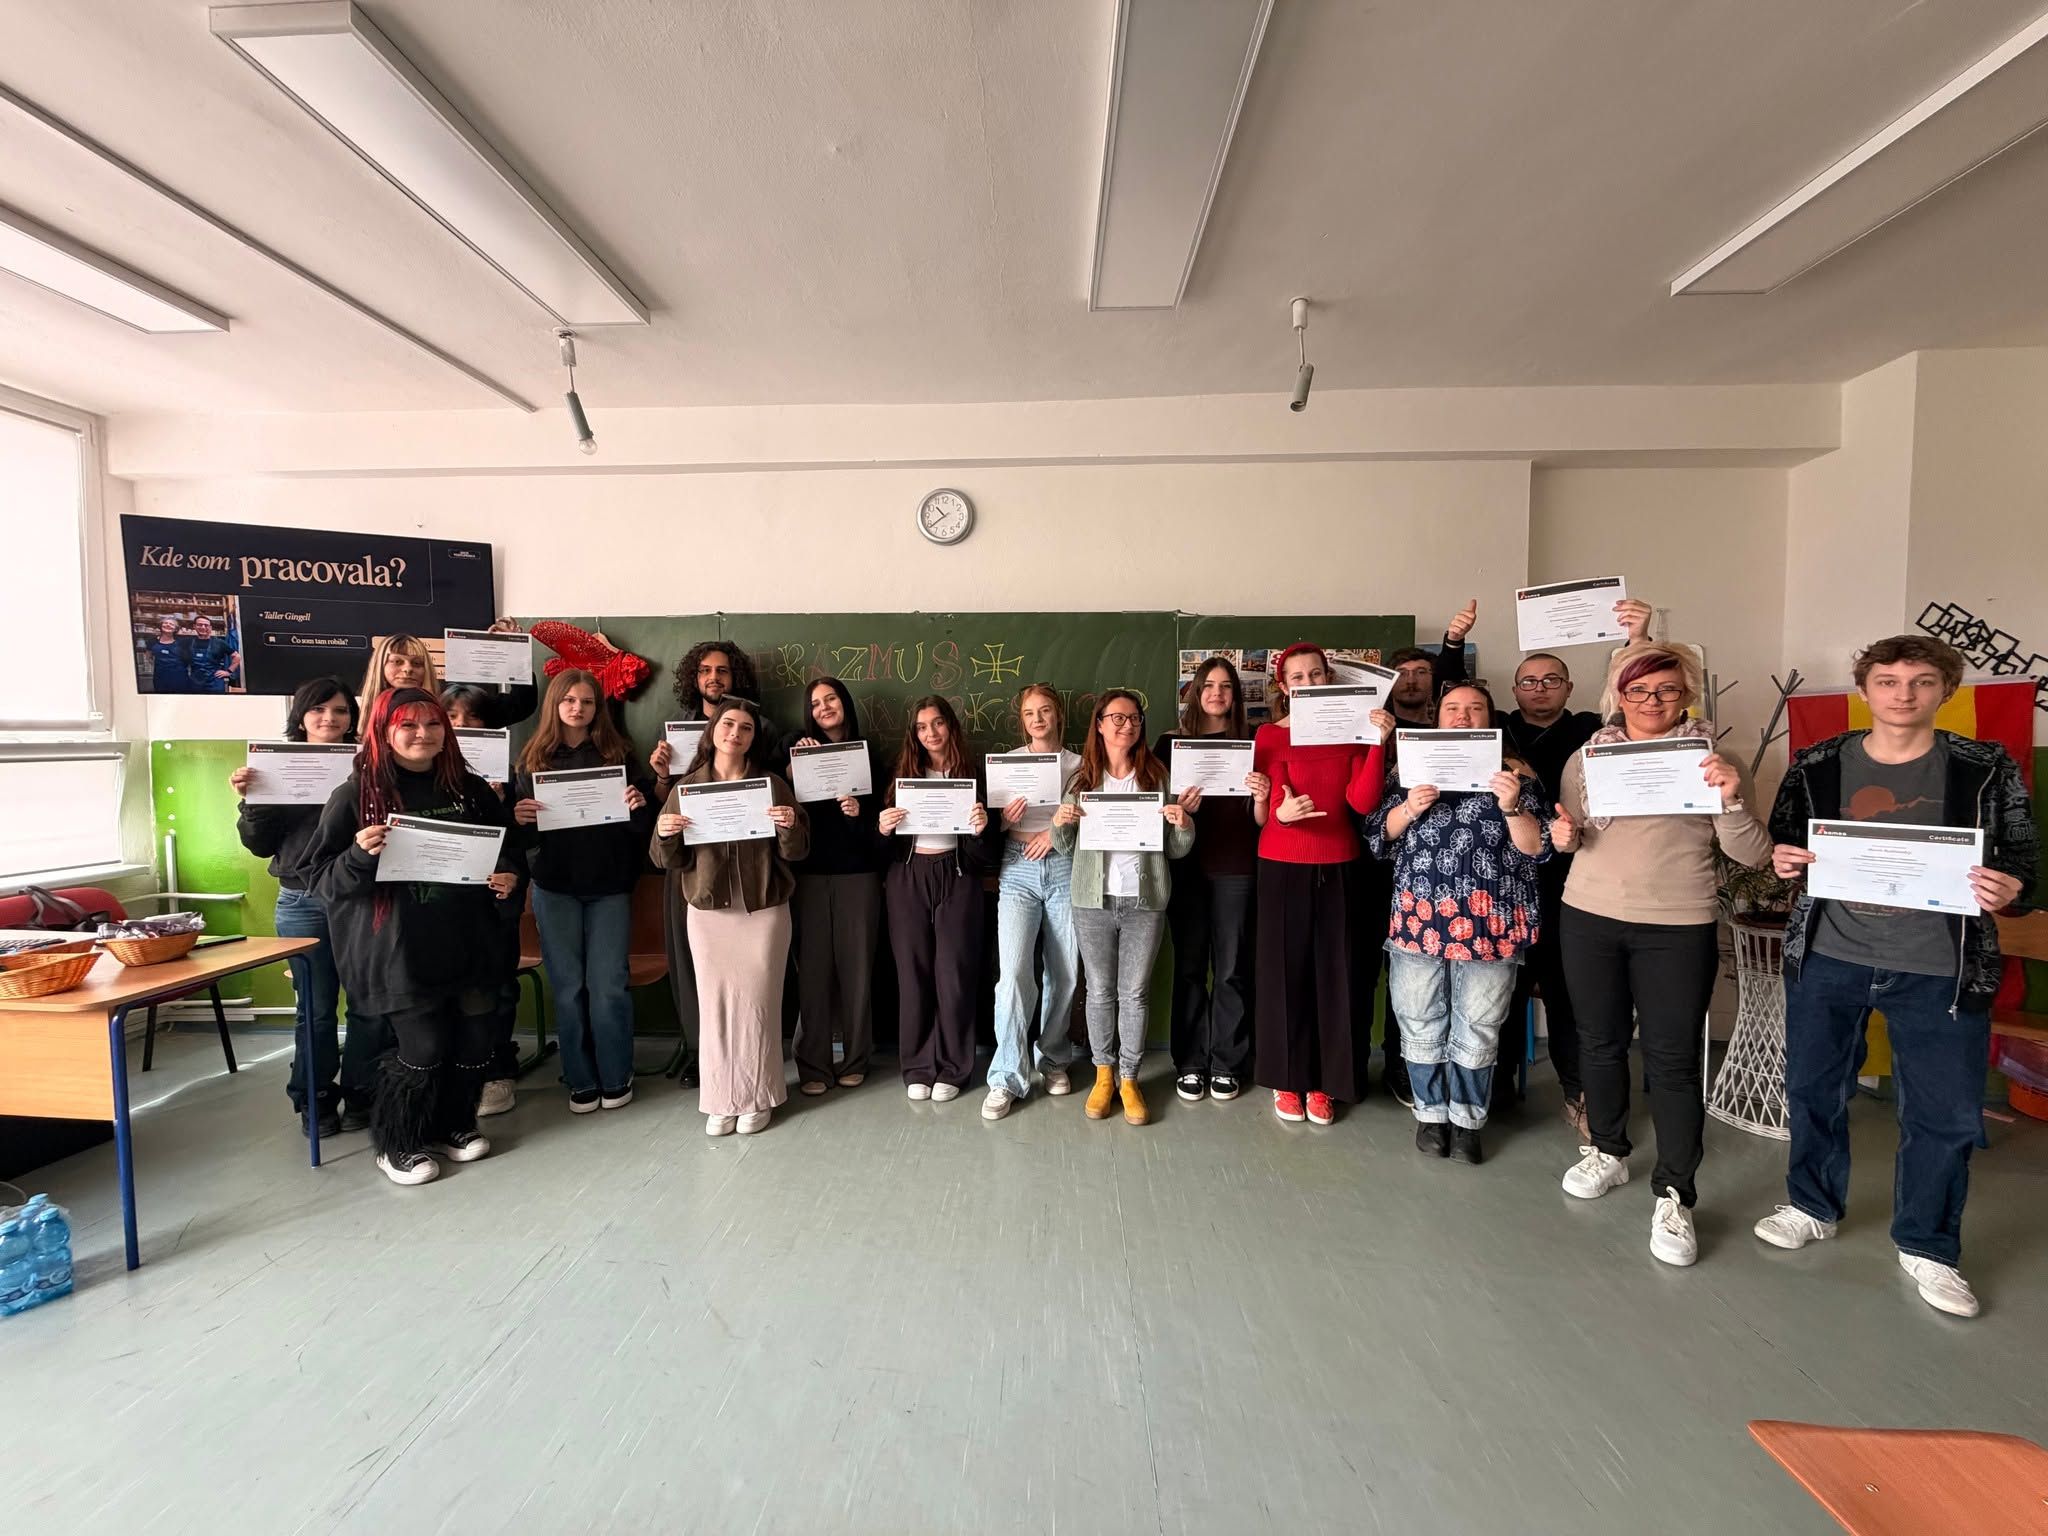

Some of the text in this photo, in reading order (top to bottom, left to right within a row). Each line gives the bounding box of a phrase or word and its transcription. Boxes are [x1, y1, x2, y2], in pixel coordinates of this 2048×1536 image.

[140, 545, 407, 588] Kde som pracovala?
[264, 610, 311, 622] Taller Gingell
[291, 635, 301, 645] Čo
[1928, 834, 1970, 843] Certificate
